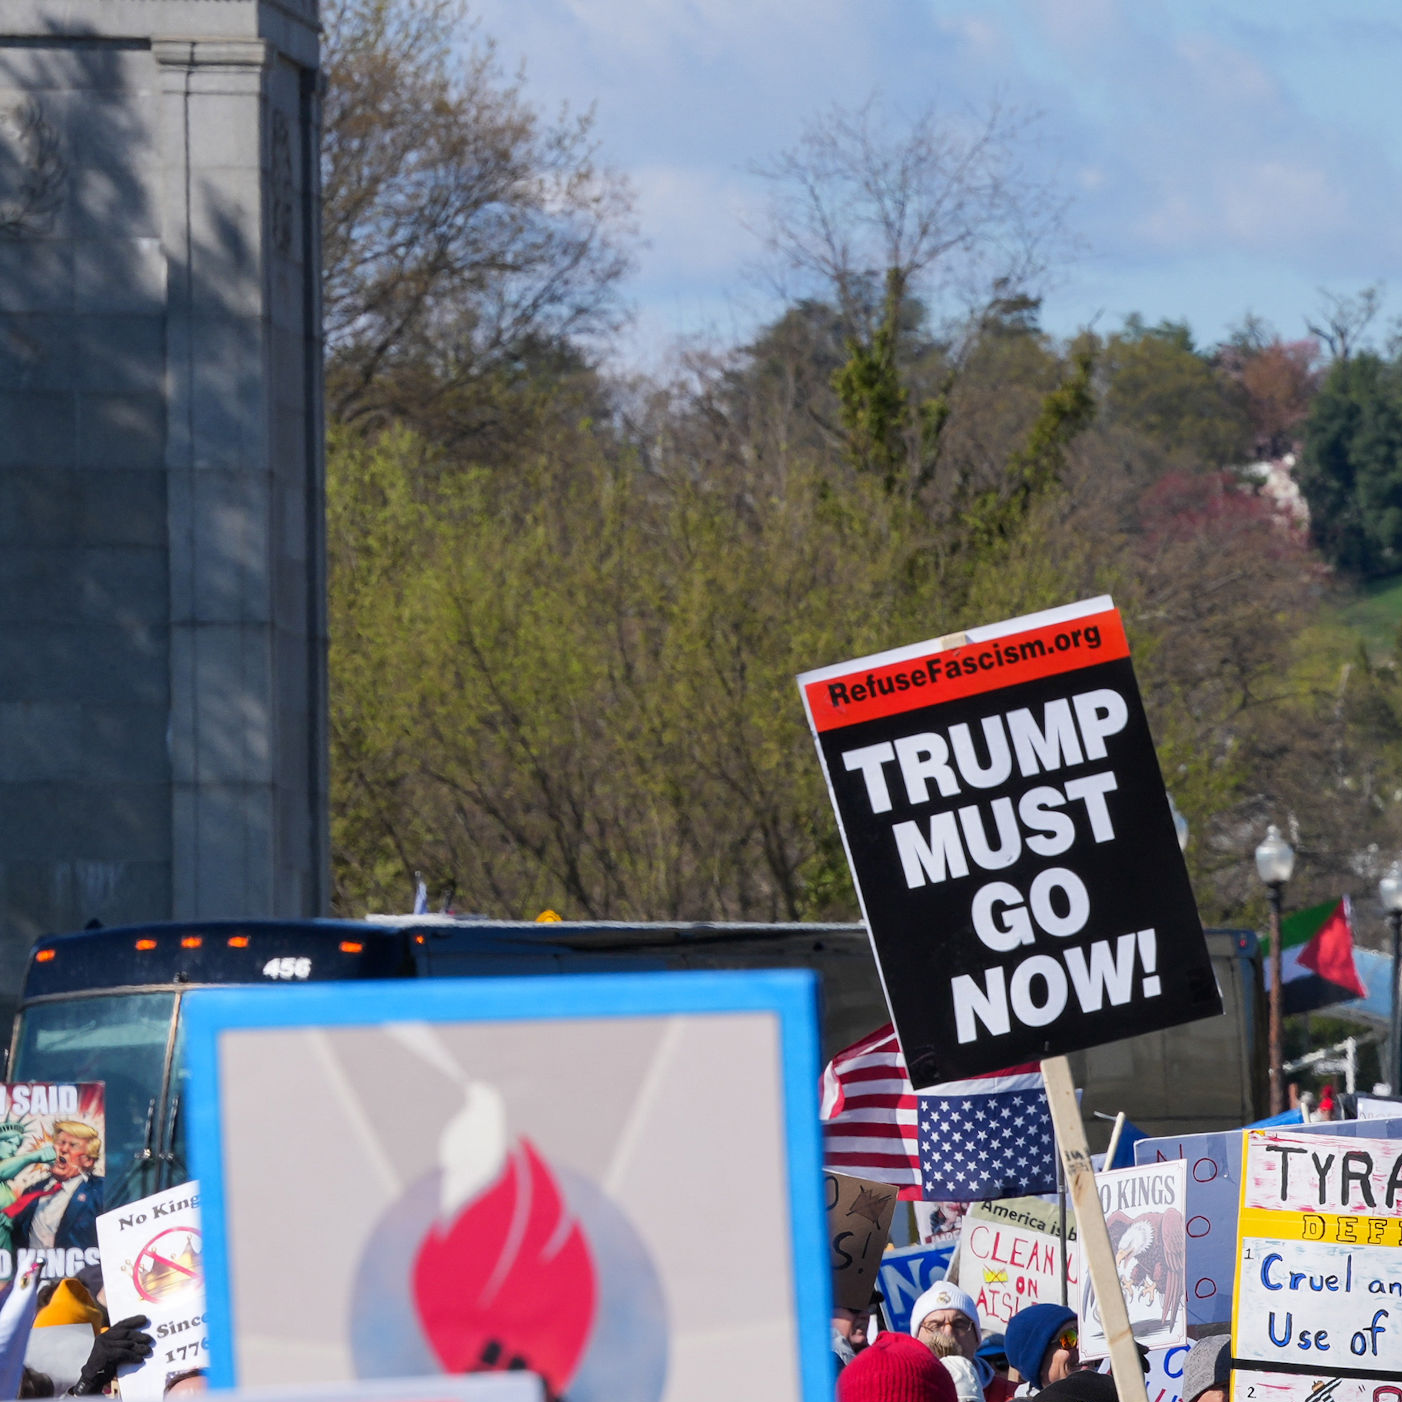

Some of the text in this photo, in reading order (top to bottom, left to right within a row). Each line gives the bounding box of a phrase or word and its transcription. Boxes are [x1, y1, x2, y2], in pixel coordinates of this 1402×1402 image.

[827, 623, 1102, 707] RefuseFascism.org
[841, 688, 1129, 814] TRUMP
[892, 770, 1118, 889] MUST
[971, 866, 1091, 952] GO
[262, 957, 312, 980] 456
[950, 928, 1163, 1045] NOW!
[12, 1085, 78, 1116] SAID
[1117, 1175, 1176, 1211] KINGS
[118, 1217, 147, 1232] No
[970, 1225, 1055, 1277] CLEAN
[1260, 1253, 1353, 1294] Cruel
[976, 1286, 1038, 1324] AISL
[1015, 1276, 1039, 1299] ON
[1268, 1311, 1331, 1351] Use
[1351, 1309, 1389, 1358] of
